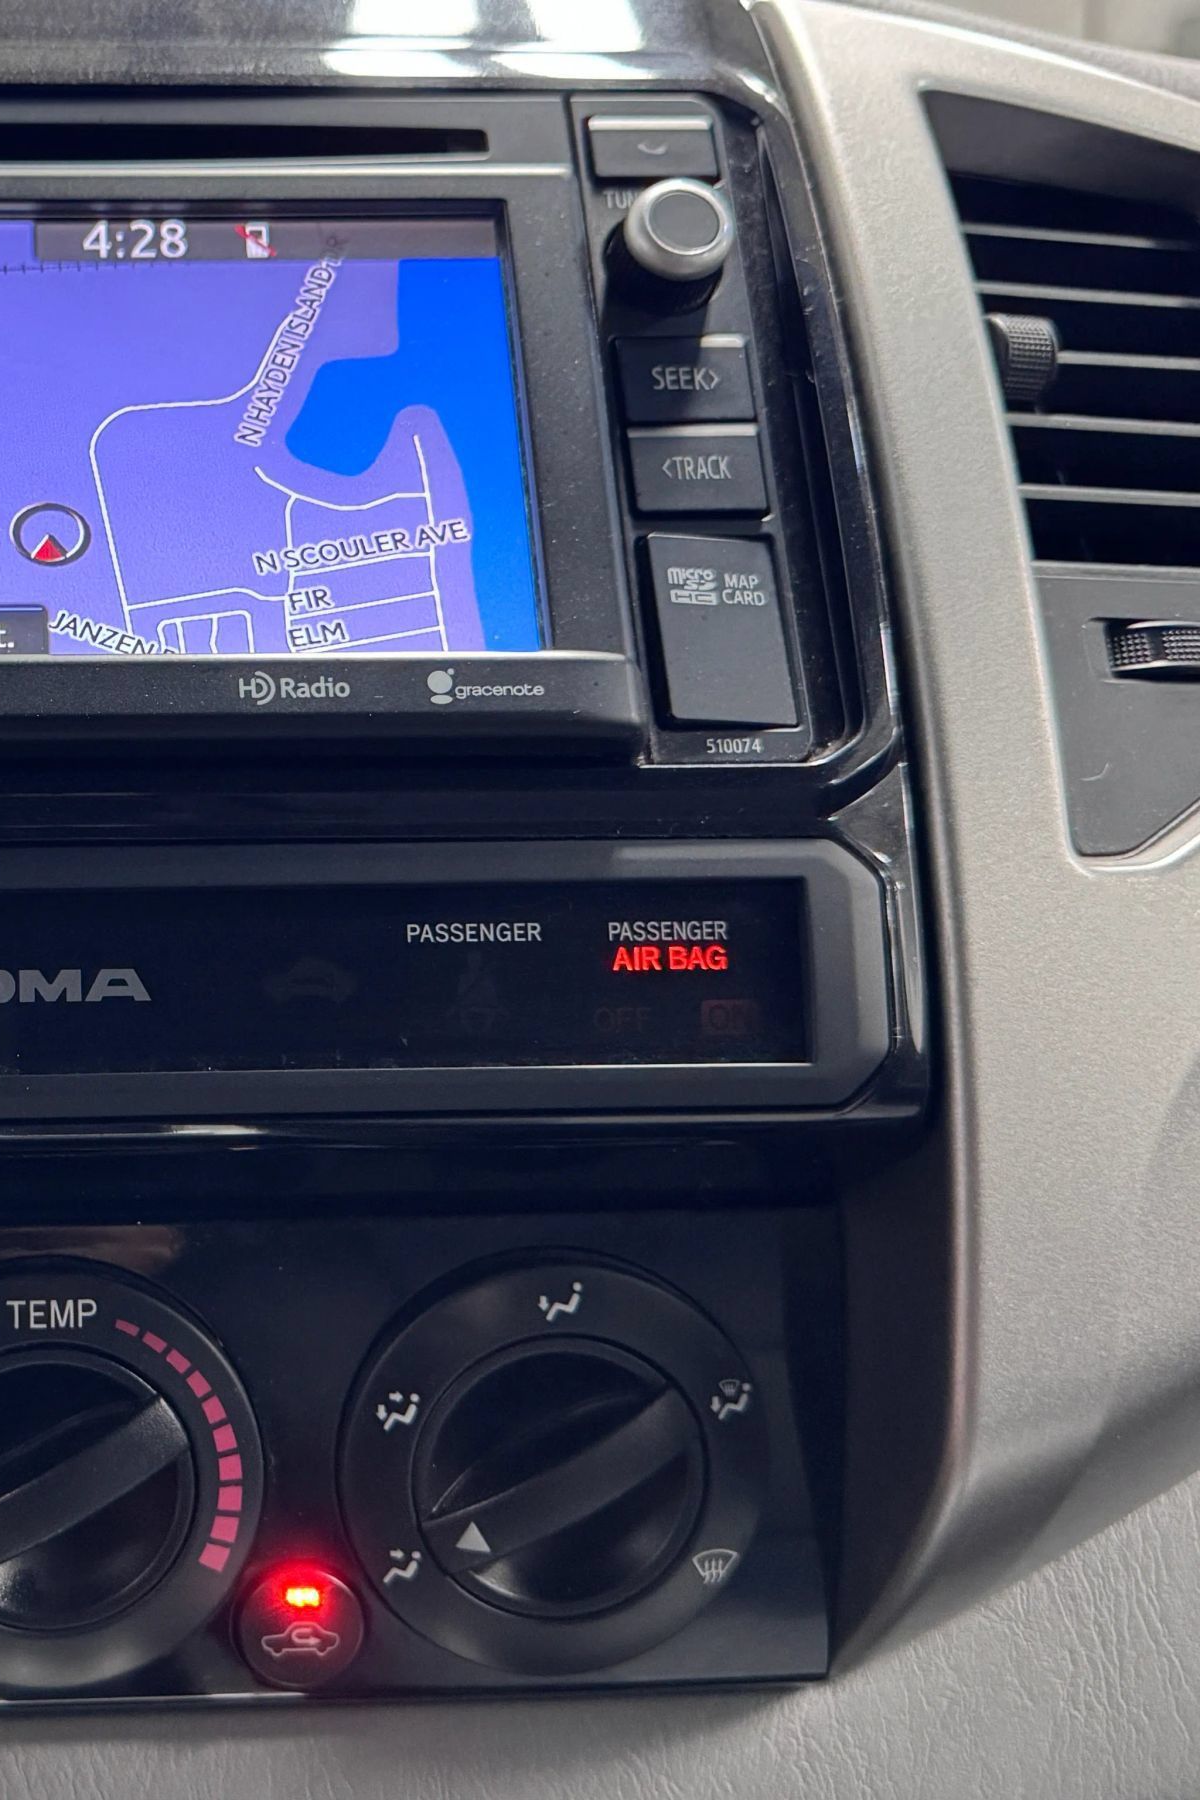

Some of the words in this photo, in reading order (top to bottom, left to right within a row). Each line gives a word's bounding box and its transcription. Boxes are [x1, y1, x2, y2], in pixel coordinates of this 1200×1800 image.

[602, 189, 638, 209] TUN
[82, 220, 189, 260] 4:28
[286, 266, 336, 339] ISLAND
[248, 340, 300, 424] HAYDEN
[236, 427, 262, 446] N
[257, 553, 279, 574] N
[283, 533, 409, 569] SCOULER
[417, 520, 468, 546] AVE
[723, 573, 760, 590] MAP
[290, 588, 331, 611] FIR
[721, 589, 766, 607] CARD
[289, 622, 346, 647] ELM
[282, 677, 351, 700] Radio
[455, 682, 545, 700] gracenote
[706, 738, 762, 755] 510074
[406, 921, 542, 944] PASSENGER
[608, 919, 728, 942] PASSENGER
[611, 945, 662, 972] AIR
[669, 944, 728, 972] BAG
[6, 1299, 98, 1330] TEMP
